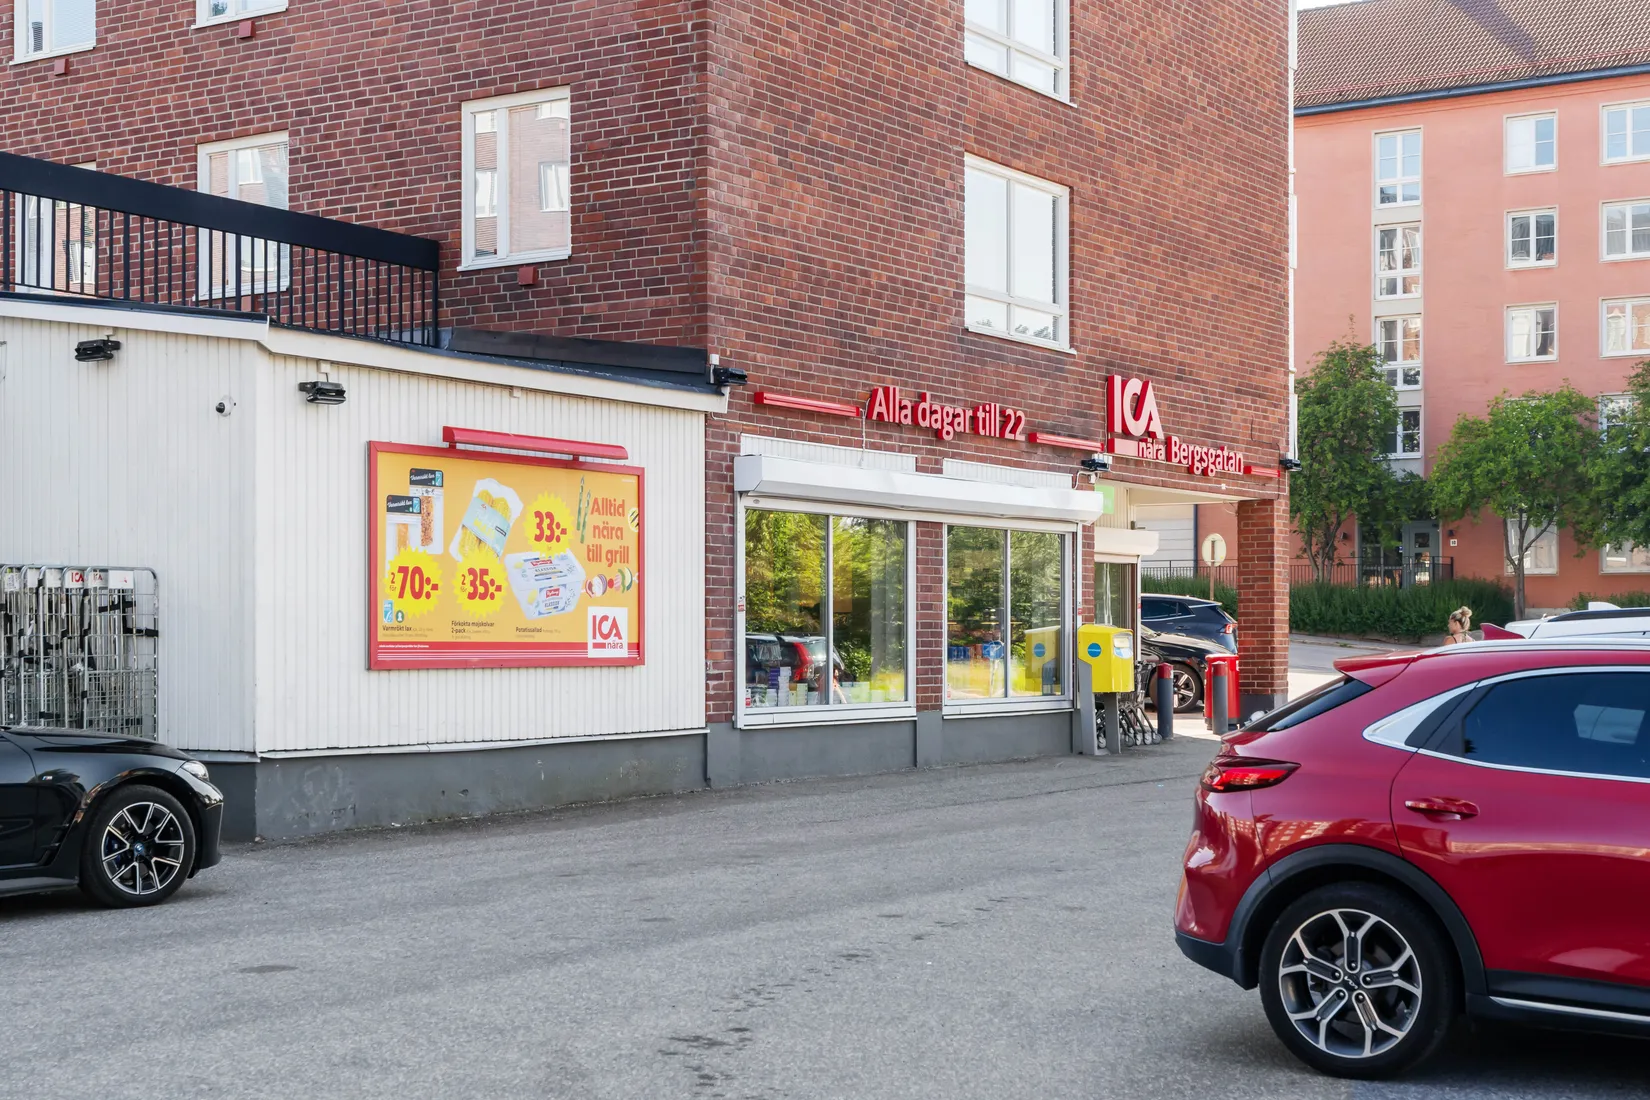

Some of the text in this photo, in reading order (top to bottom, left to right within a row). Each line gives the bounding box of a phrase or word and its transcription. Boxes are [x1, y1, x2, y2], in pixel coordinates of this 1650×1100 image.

[868, 386, 1026, 442] Alla dagar till 22
[1109, 374, 1165, 440] ICA
[1139, 435, 1244, 477] nära Bergsgatan
[590, 497, 626, 517] Alltid
[533, 510, 567, 543] 33:-
[592, 521, 624, 540] nära
[586, 543, 630, 568] till grill
[390, 572, 396, 584] 2
[397, 566, 439, 600] 70:-
[461, 574, 466, 586] 2
[467, 567, 502, 601] 35:-
[592, 614, 623, 640] ICA
[607, 640, 624, 650] nära
